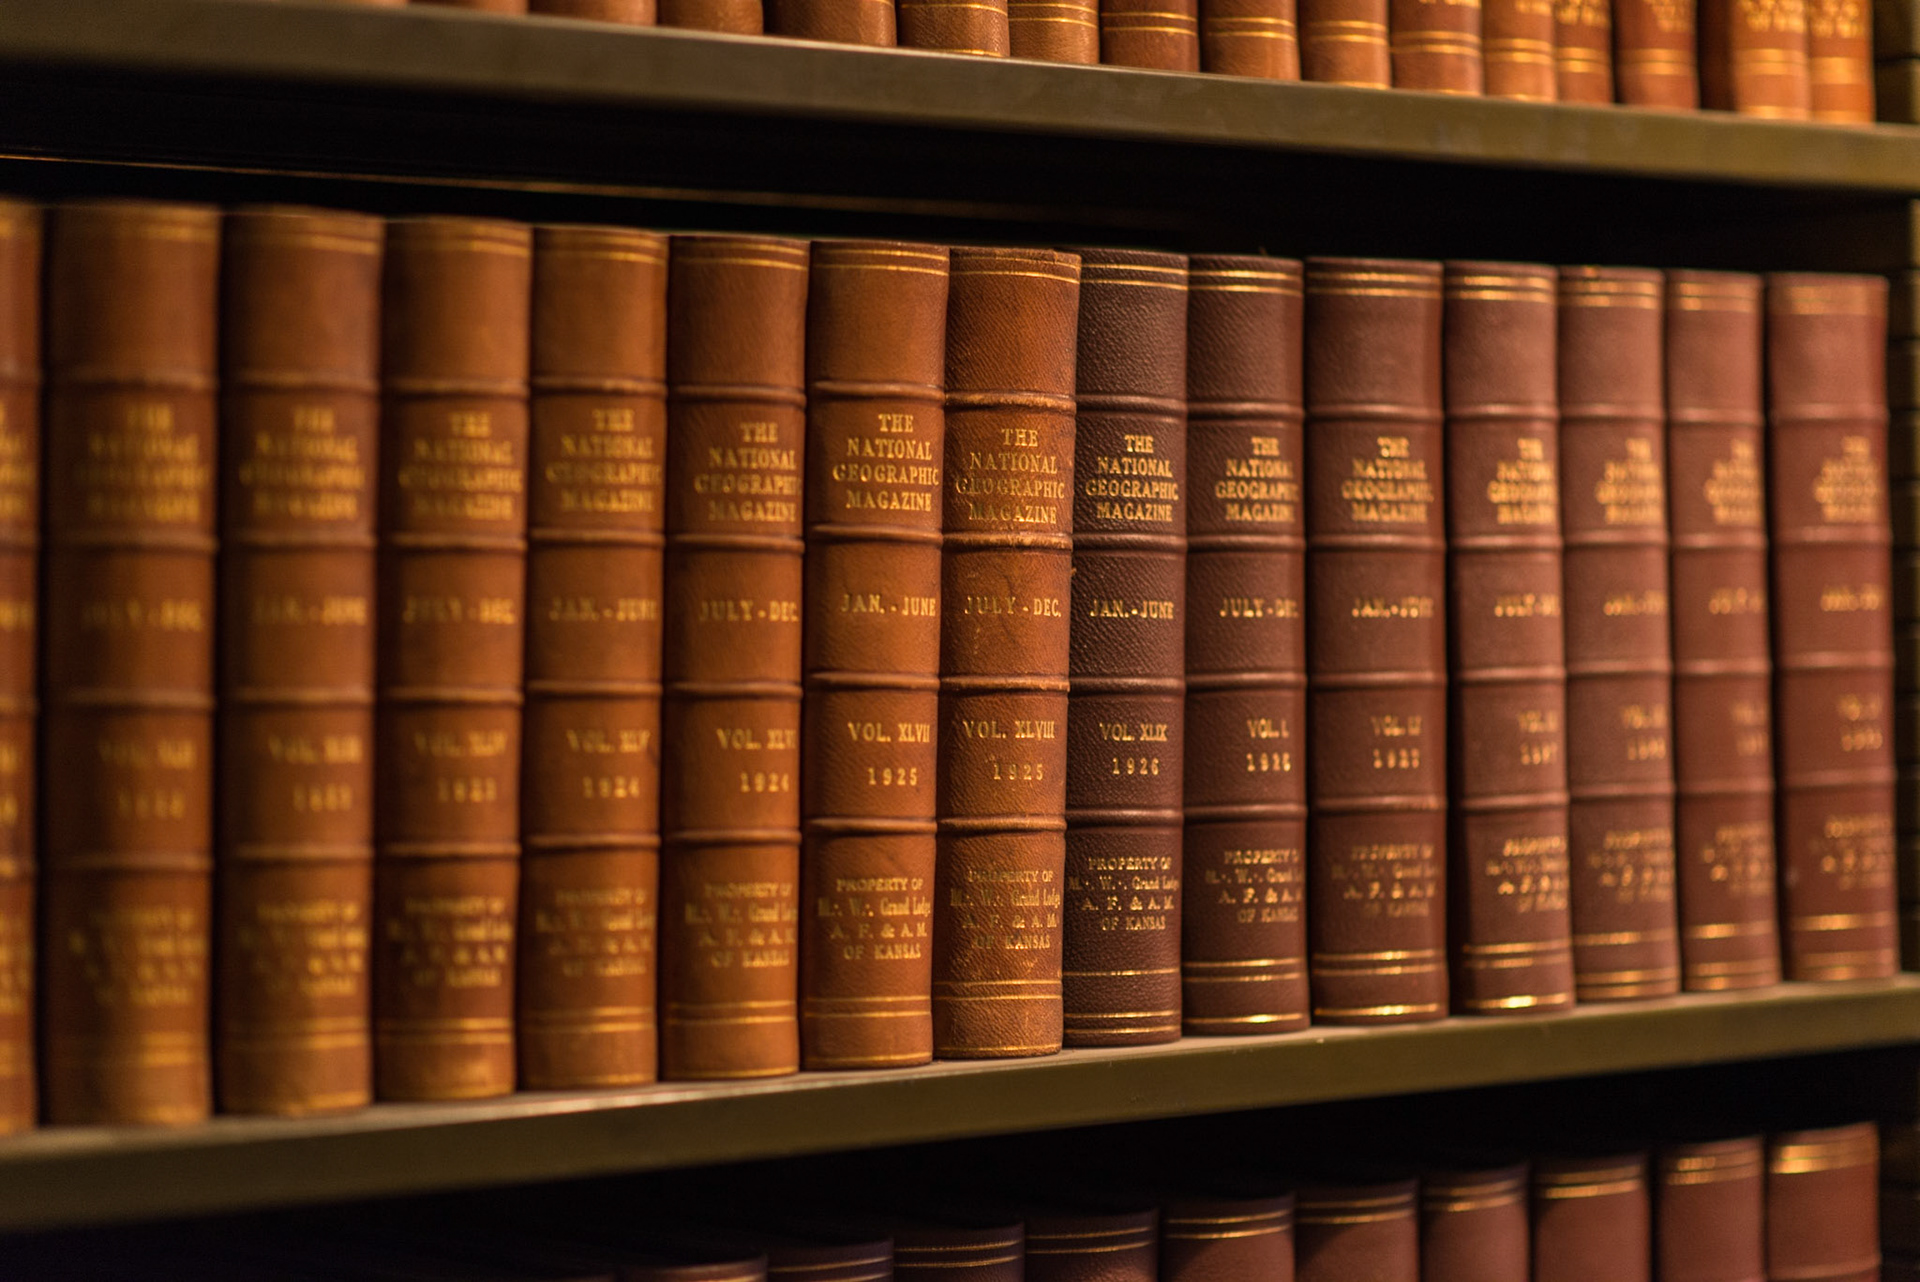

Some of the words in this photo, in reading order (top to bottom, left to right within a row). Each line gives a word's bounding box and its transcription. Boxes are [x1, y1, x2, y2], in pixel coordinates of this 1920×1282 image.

[740, 423, 778, 442] THE
[878, 414, 914, 432] THE
[1001, 429, 1038, 447] THE
[1124, 434, 1154, 453] THE
[1251, 437, 1280, 456] THE
[846, 437, 933, 461] NATIONAL
[708, 448, 796, 470] NATIONAL
[969, 451, 1058, 475] NATIONAL
[1096, 456, 1174, 478] NATIONAL
[832, 464, 939, 486] GEOGRAPHIC
[955, 477, 1065, 499] GEOGRAPHIC
[1085, 479, 1180, 500] GEOGRAPHIC
[845, 490, 932, 512] MAGAZINE
[968, 503, 1057, 524] MAGAZINE
[1096, 503, 1173, 522] MAGAZINE
[699, 600, 753, 621] JULY
[841, 594, 885, 615] JAN.
[902, 596, 936, 617] JUNE
[964, 596, 1016, 615] JULY
[1033, 598, 1062, 618] DEC.
[717, 729, 761, 750] VOL.
[847, 722, 891, 742] VOL.
[898, 723, 930, 743] XLVII
[962, 720, 1007, 739] VOL.
[1015, 720, 1055, 740] XLVIII
[1100, 722, 1135, 742] VOL.
[1140, 723, 1168, 742] XLIX
[993, 763, 1044, 781] 1925
[1112, 757, 1160, 776] 1926
[868, 767, 918, 786] 1925
[1088, 856, 1158, 872] PROPERTY
[1160, 856, 1172, 871] OF
[836, 878, 907, 892] PROPERTY
[911, 878, 923, 891] OF
[1042, 870, 1053, 883] OF
[1129, 896, 1143, 912] &
[880, 923, 895, 939] &
[1012, 915, 1026, 930] &
[1101, 916, 1119, 932] OF
[1125, 916, 1167, 931] KANSAS
[1005, 934, 1051, 951] KANSAS
[874, 944, 921, 961] KANSAS
